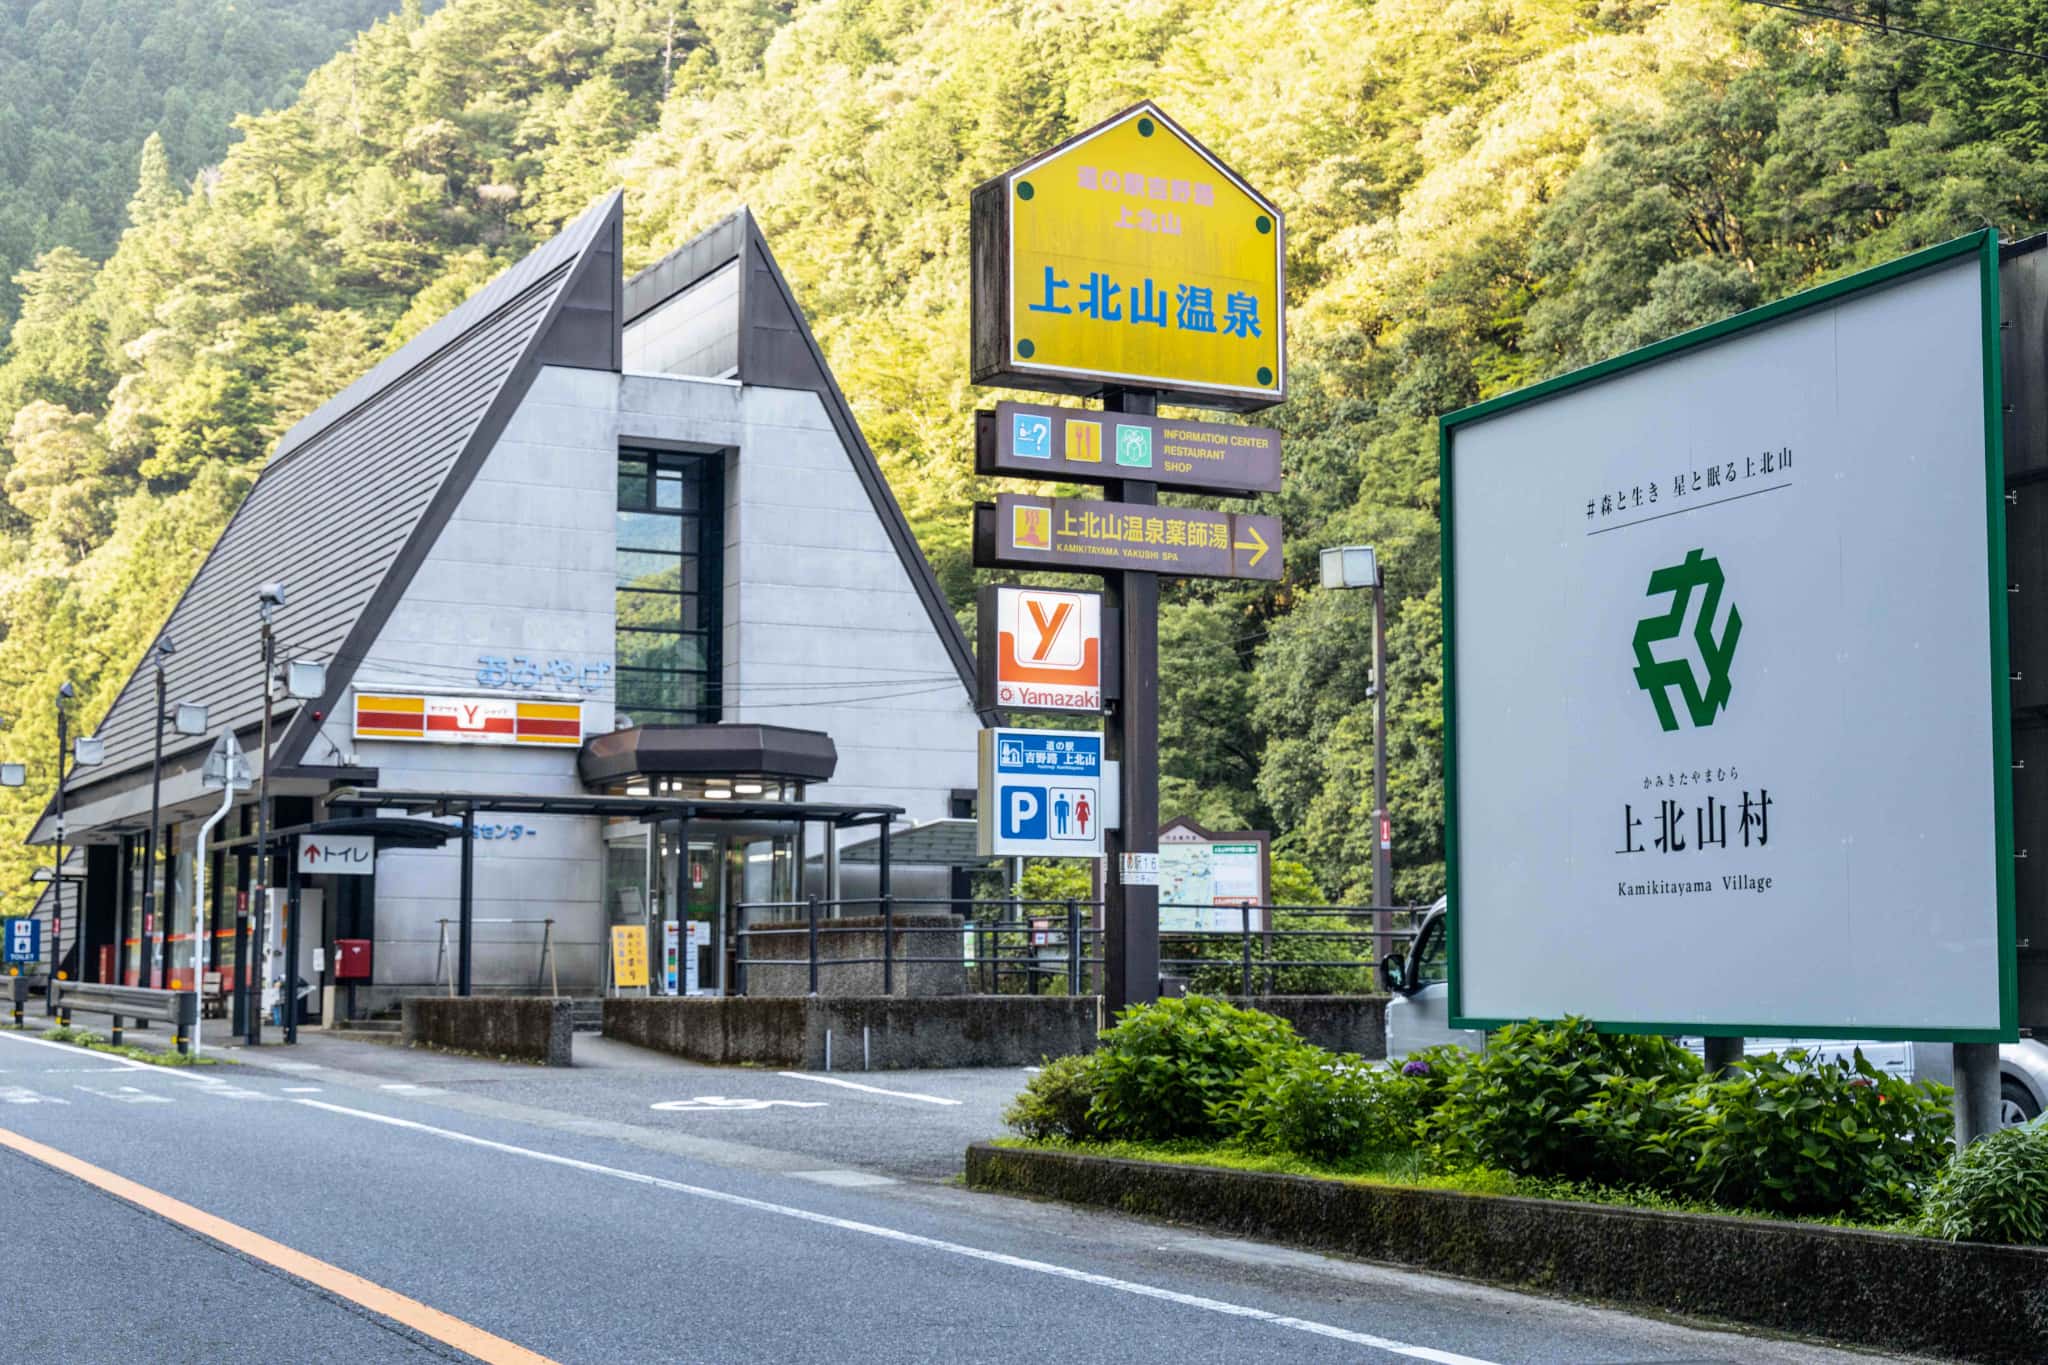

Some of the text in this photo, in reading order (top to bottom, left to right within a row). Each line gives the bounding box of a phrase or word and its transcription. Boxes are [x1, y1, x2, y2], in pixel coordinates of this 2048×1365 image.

[1114, 205, 1182, 236] 上北山
[1028, 266, 1263, 339] 上北山温泉
[1163, 429, 1269, 448] INFORMATION CENTER
[1163, 445, 1226, 460] RESTAURANT
[1164, 460, 1192, 472] SHOP
[1673, 446, 1793, 497] 星と眠る上北山
[1056, 509, 1228, 550] 上北山温泉薬師湯
[1056, 543, 1179, 561] KAMIKITAYAMA YAKUSHI SPA
[476, 655, 611, 693] おみやげ
[1018, 687, 1100, 708] Yamazaki
[1063, 753, 1096, 766] 上北山
[1643, 766, 1740, 789] かみきたやまむら
[1011, 791, 1039, 834] P
[1615, 788, 1774, 855] 上北山村
[322, 844, 369, 863] トイレ
[1617, 873, 1774, 898] Kamikitayama Village
